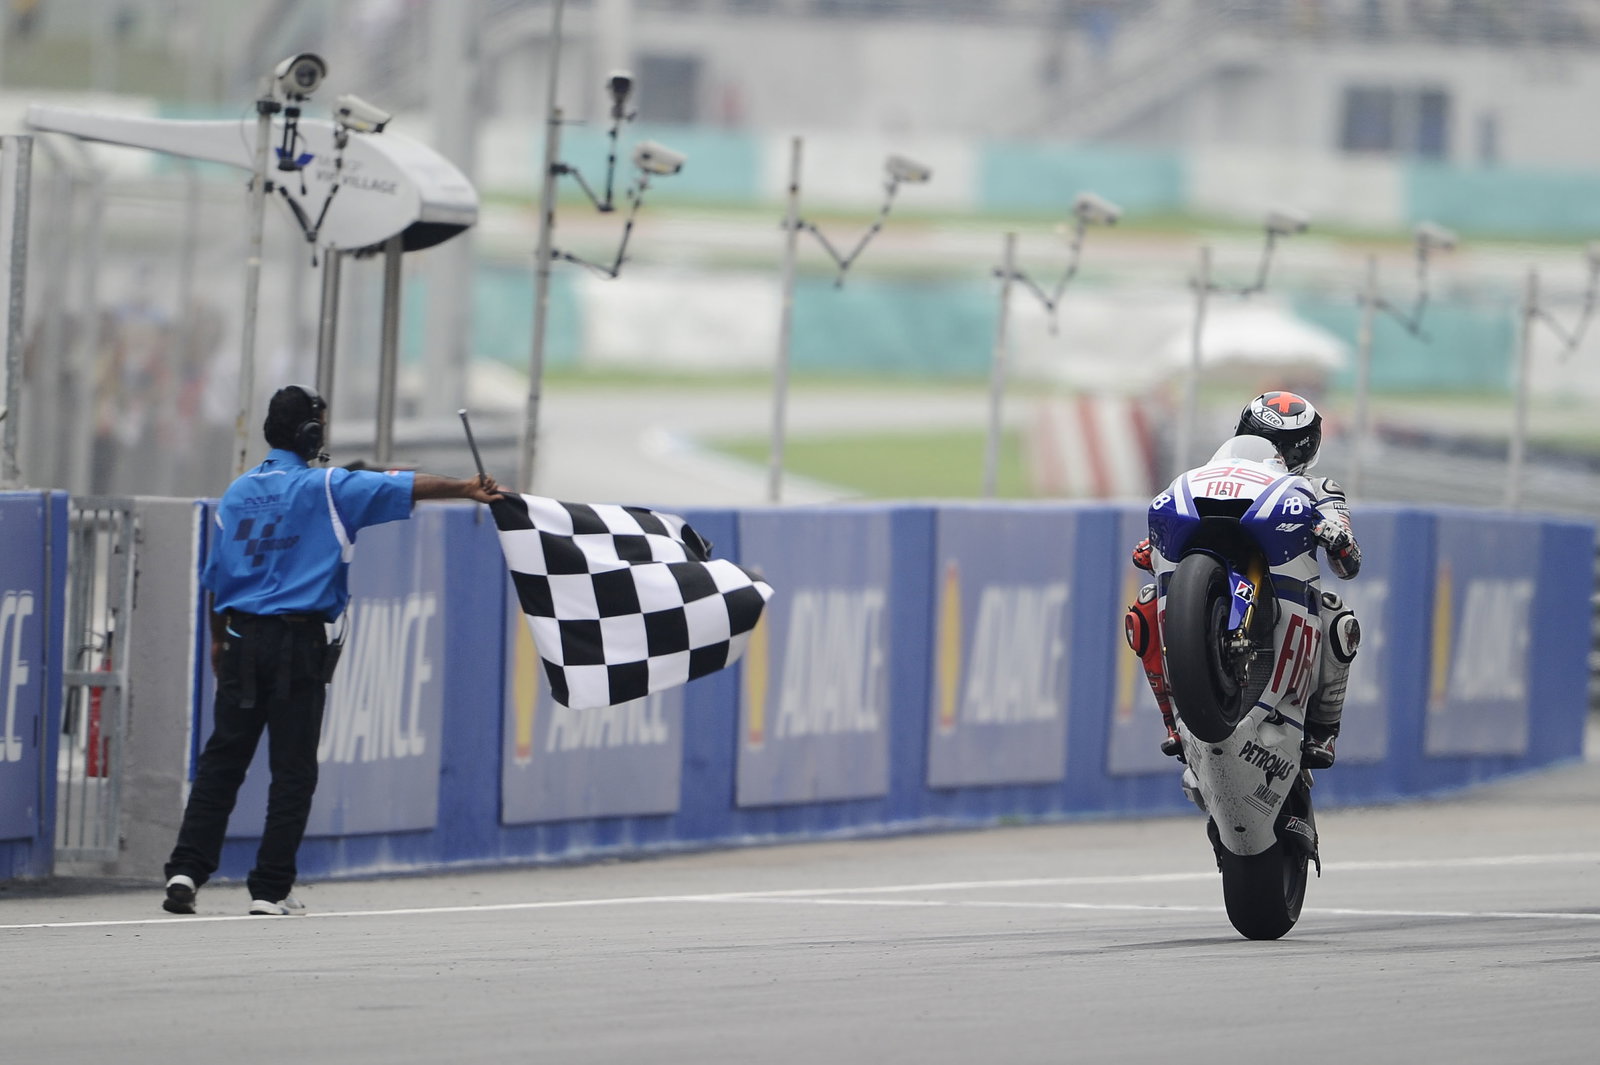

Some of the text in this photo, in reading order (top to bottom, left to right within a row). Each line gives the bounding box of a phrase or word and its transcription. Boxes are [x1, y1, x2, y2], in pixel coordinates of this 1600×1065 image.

[1206, 481, 1246, 498] FIAT
[316, 592, 436, 764] DVANCE
[1238, 740, 1295, 781] PETRONAS
